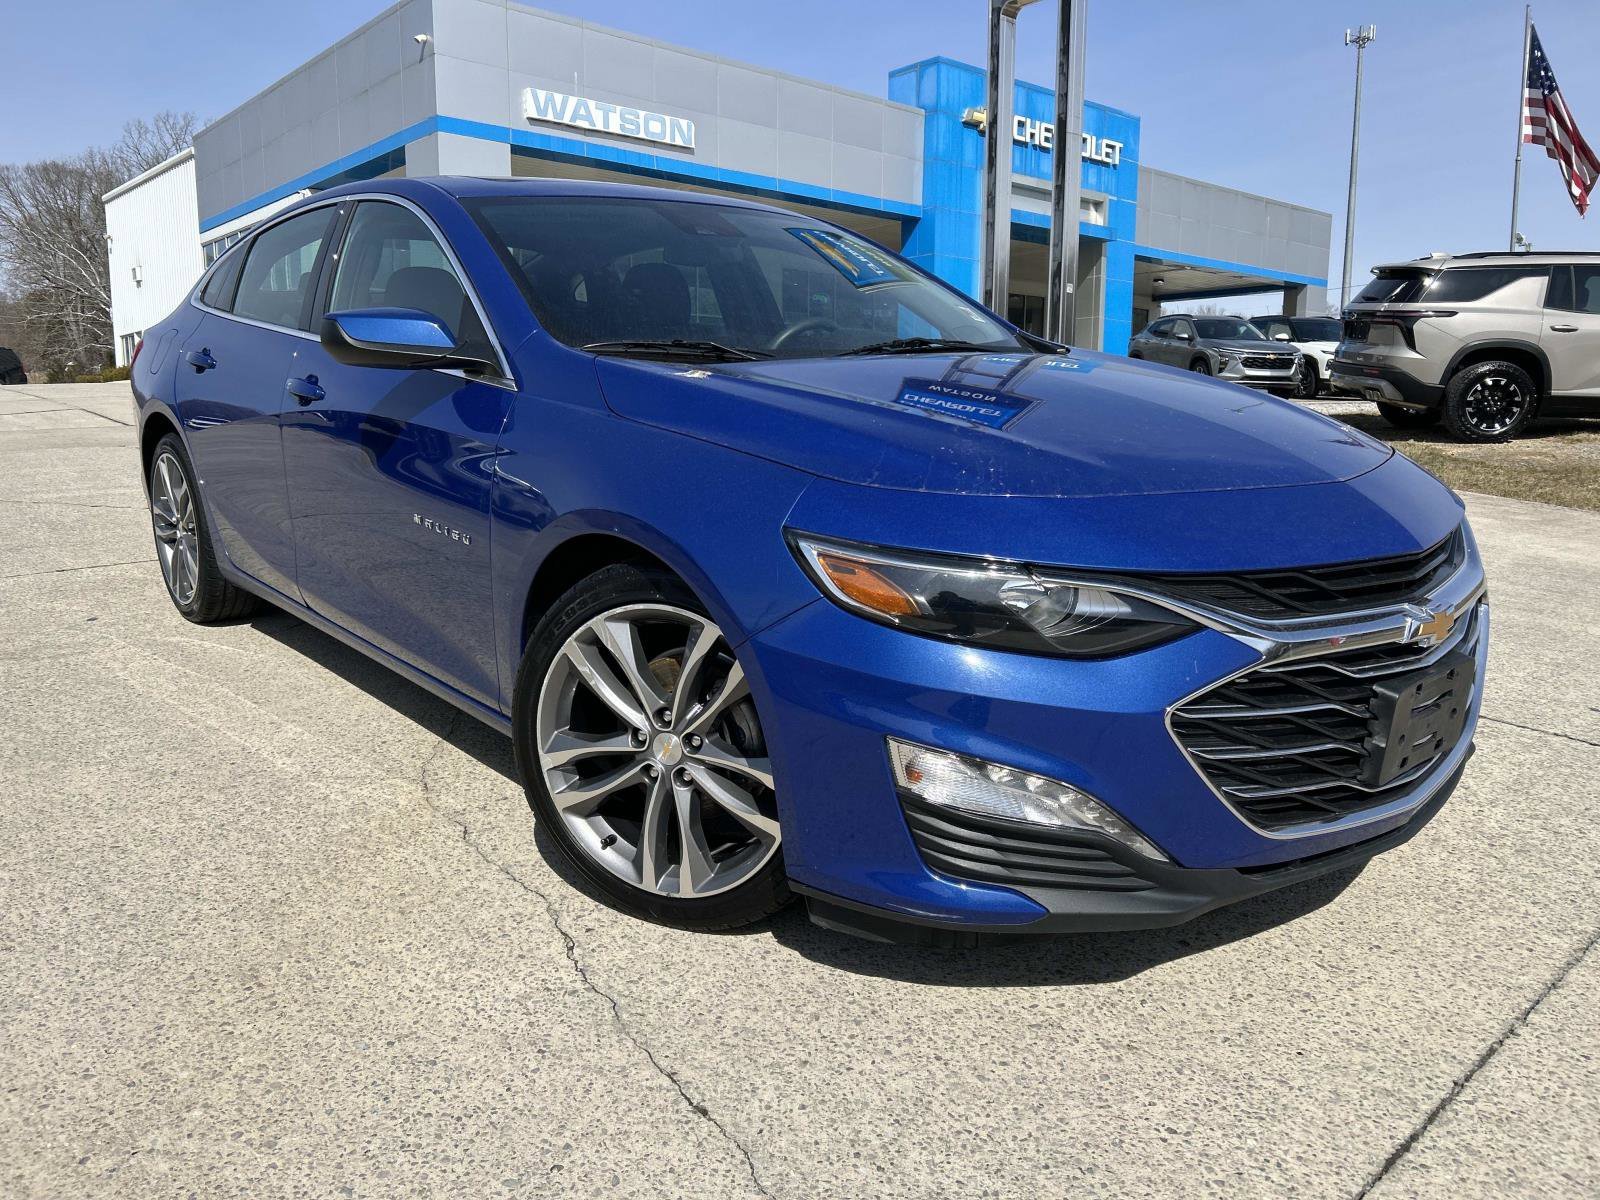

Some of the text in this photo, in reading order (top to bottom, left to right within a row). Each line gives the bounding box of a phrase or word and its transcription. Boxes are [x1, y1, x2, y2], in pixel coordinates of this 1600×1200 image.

[531, 88, 693, 145] WATSON
[1013, 115, 1124, 165] CHEOLET
[413, 513, 469, 545] MALIBU
